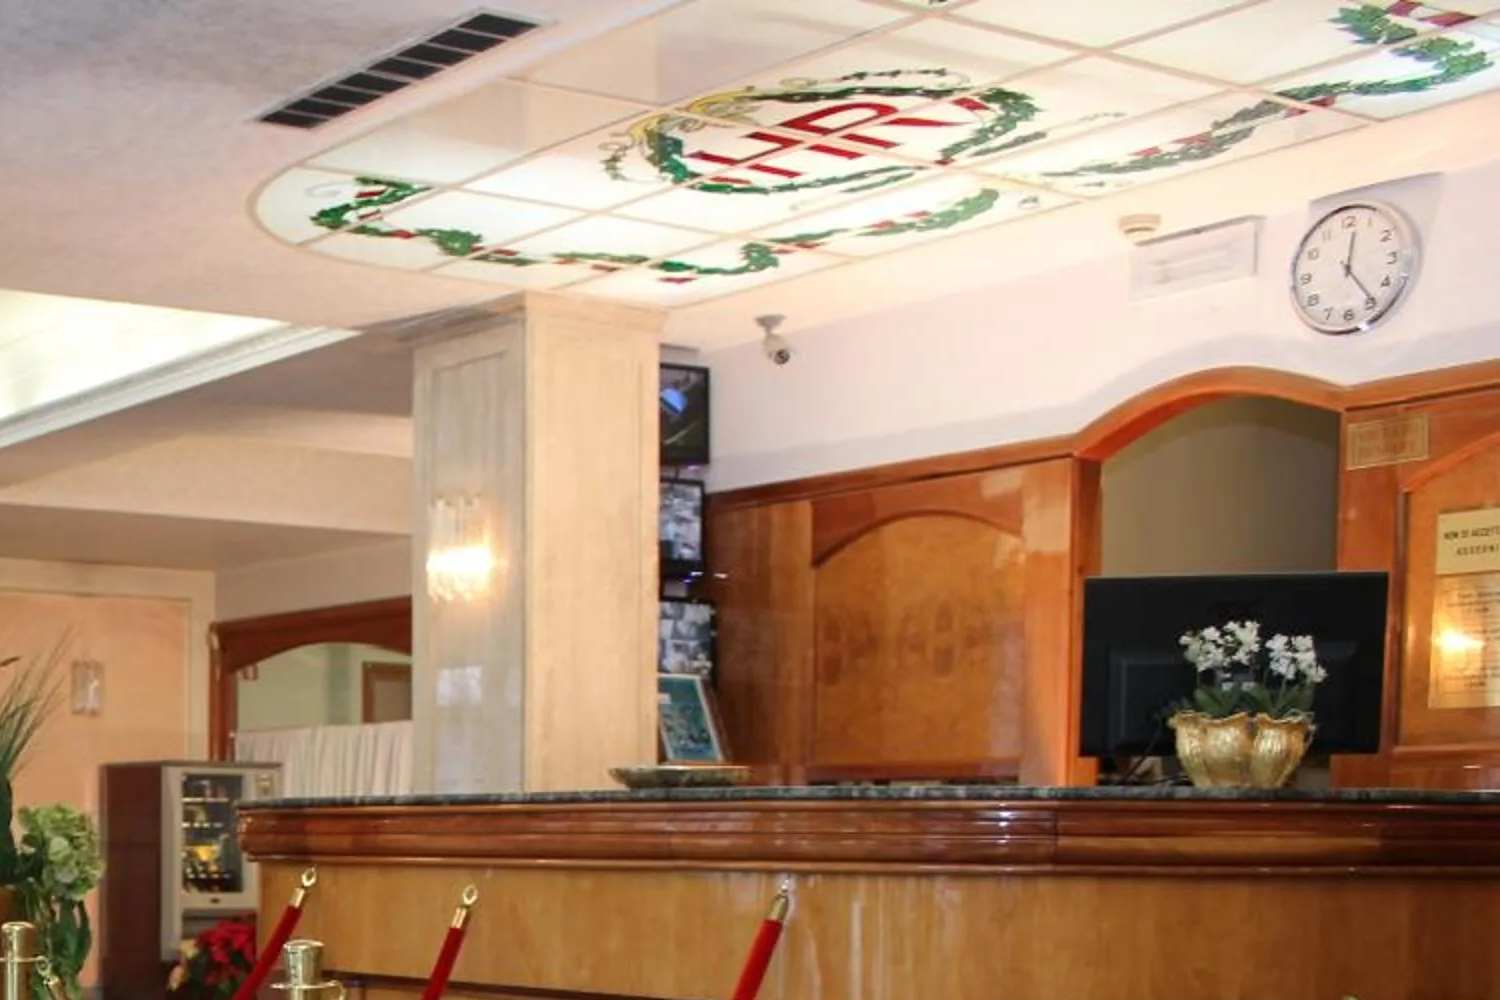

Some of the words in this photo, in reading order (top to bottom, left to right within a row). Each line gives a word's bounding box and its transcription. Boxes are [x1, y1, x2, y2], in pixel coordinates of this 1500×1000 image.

[1340, 215, 1357, 229] 12
[1379, 229, 1392, 243] 2
[1386, 251, 1398, 265] 3
[1301, 273, 1313, 285] 9
[1380, 275, 1392, 288] 4
[1307, 293, 1320, 307] 8
[1323, 307, 1333, 321] 7
[1343, 308, 1355, 321] 6
